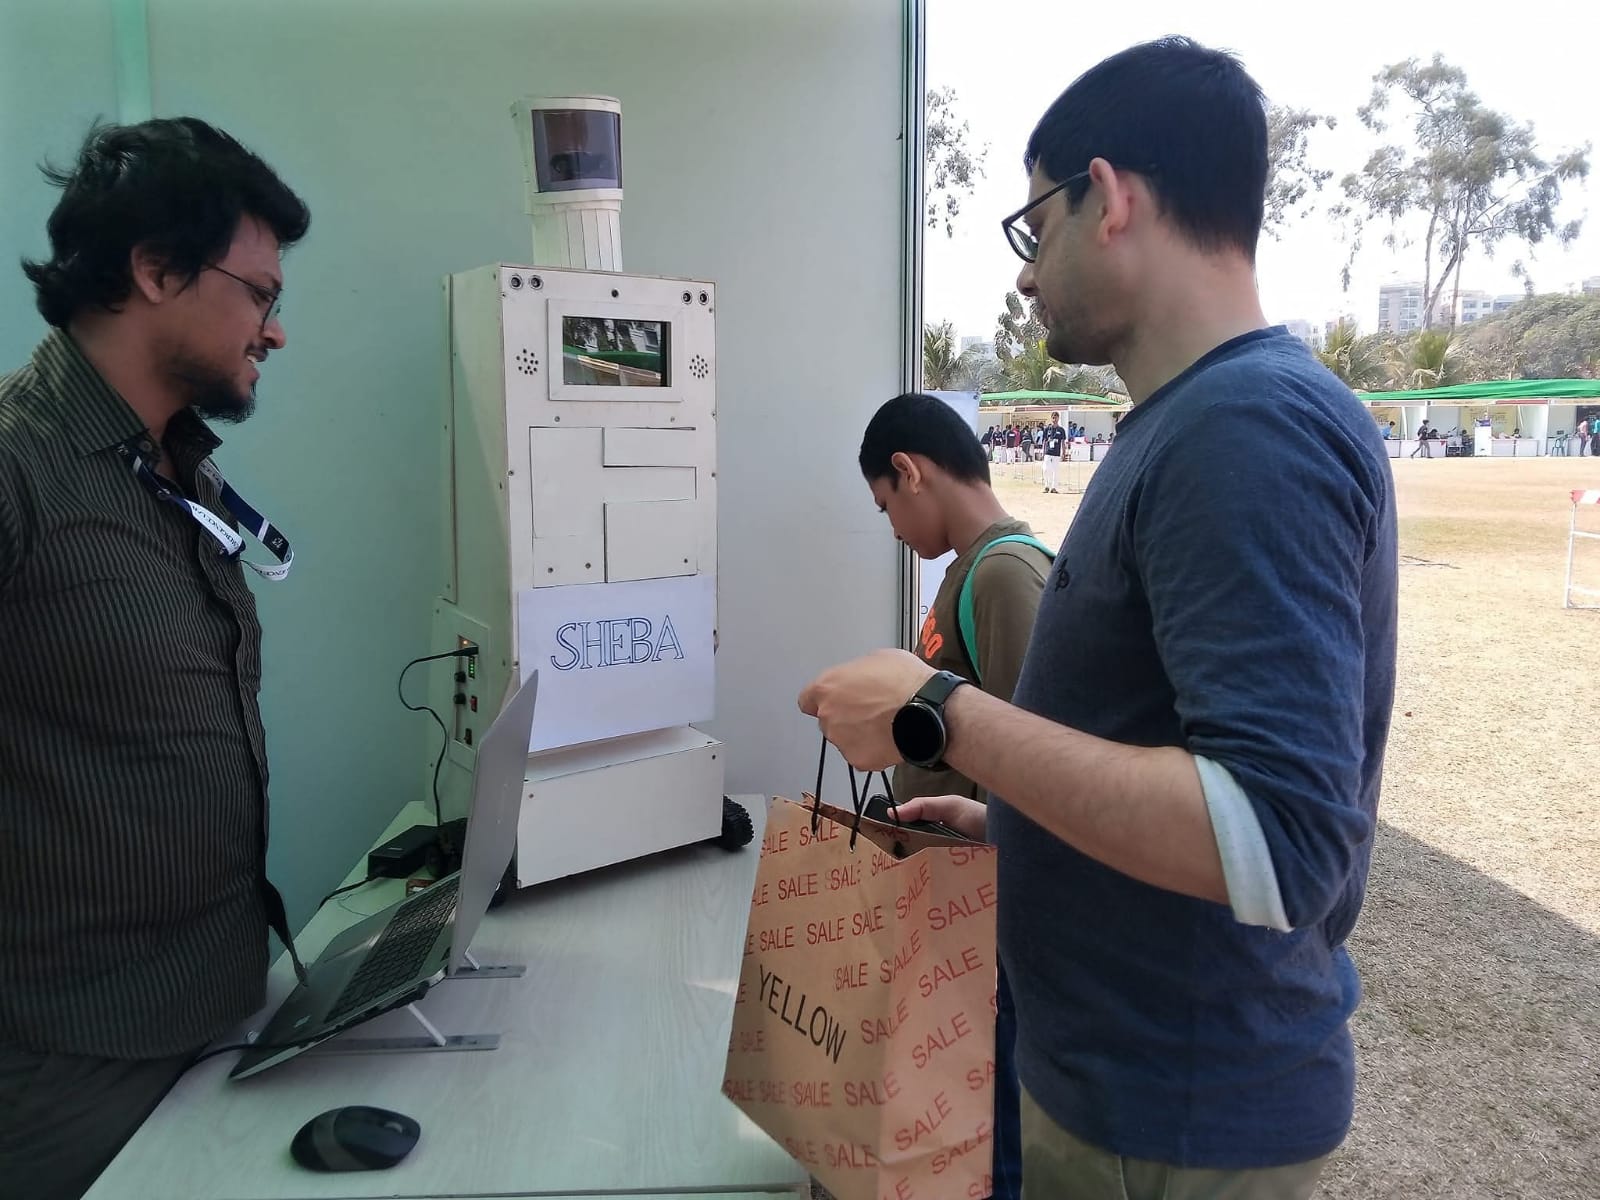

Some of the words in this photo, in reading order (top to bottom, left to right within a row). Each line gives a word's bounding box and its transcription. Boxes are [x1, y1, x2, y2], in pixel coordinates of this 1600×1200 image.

[550, 614, 684, 670] SHEBA
[761, 831, 789, 858] ALE
[948, 847, 998, 866] SA
[778, 873, 819, 900] SALE
[896, 861, 931, 919] SALE
[927, 882, 998, 930] SALE
[760, 926, 795, 952] SALE
[806, 917, 845, 945] SALE
[852, 905, 884, 936] SALE
[835, 962, 869, 991] SALE
[880, 929, 921, 984] SALE
[918, 946, 984, 998] SALE
[759, 963, 847, 1064] YELLOW
[860, 997, 910, 1045] SALE
[911, 1011, 973, 1069] SALE
[792, 1081, 832, 1107] SALE
[844, 1071, 901, 1107] SALE
[966, 1060, 995, 1091] SA
[894, 1091, 953, 1151] SALE
[824, 1143, 877, 1169] SALE
[931, 1121, 992, 1175] SALE
[968, 1173, 993, 1199] SA
